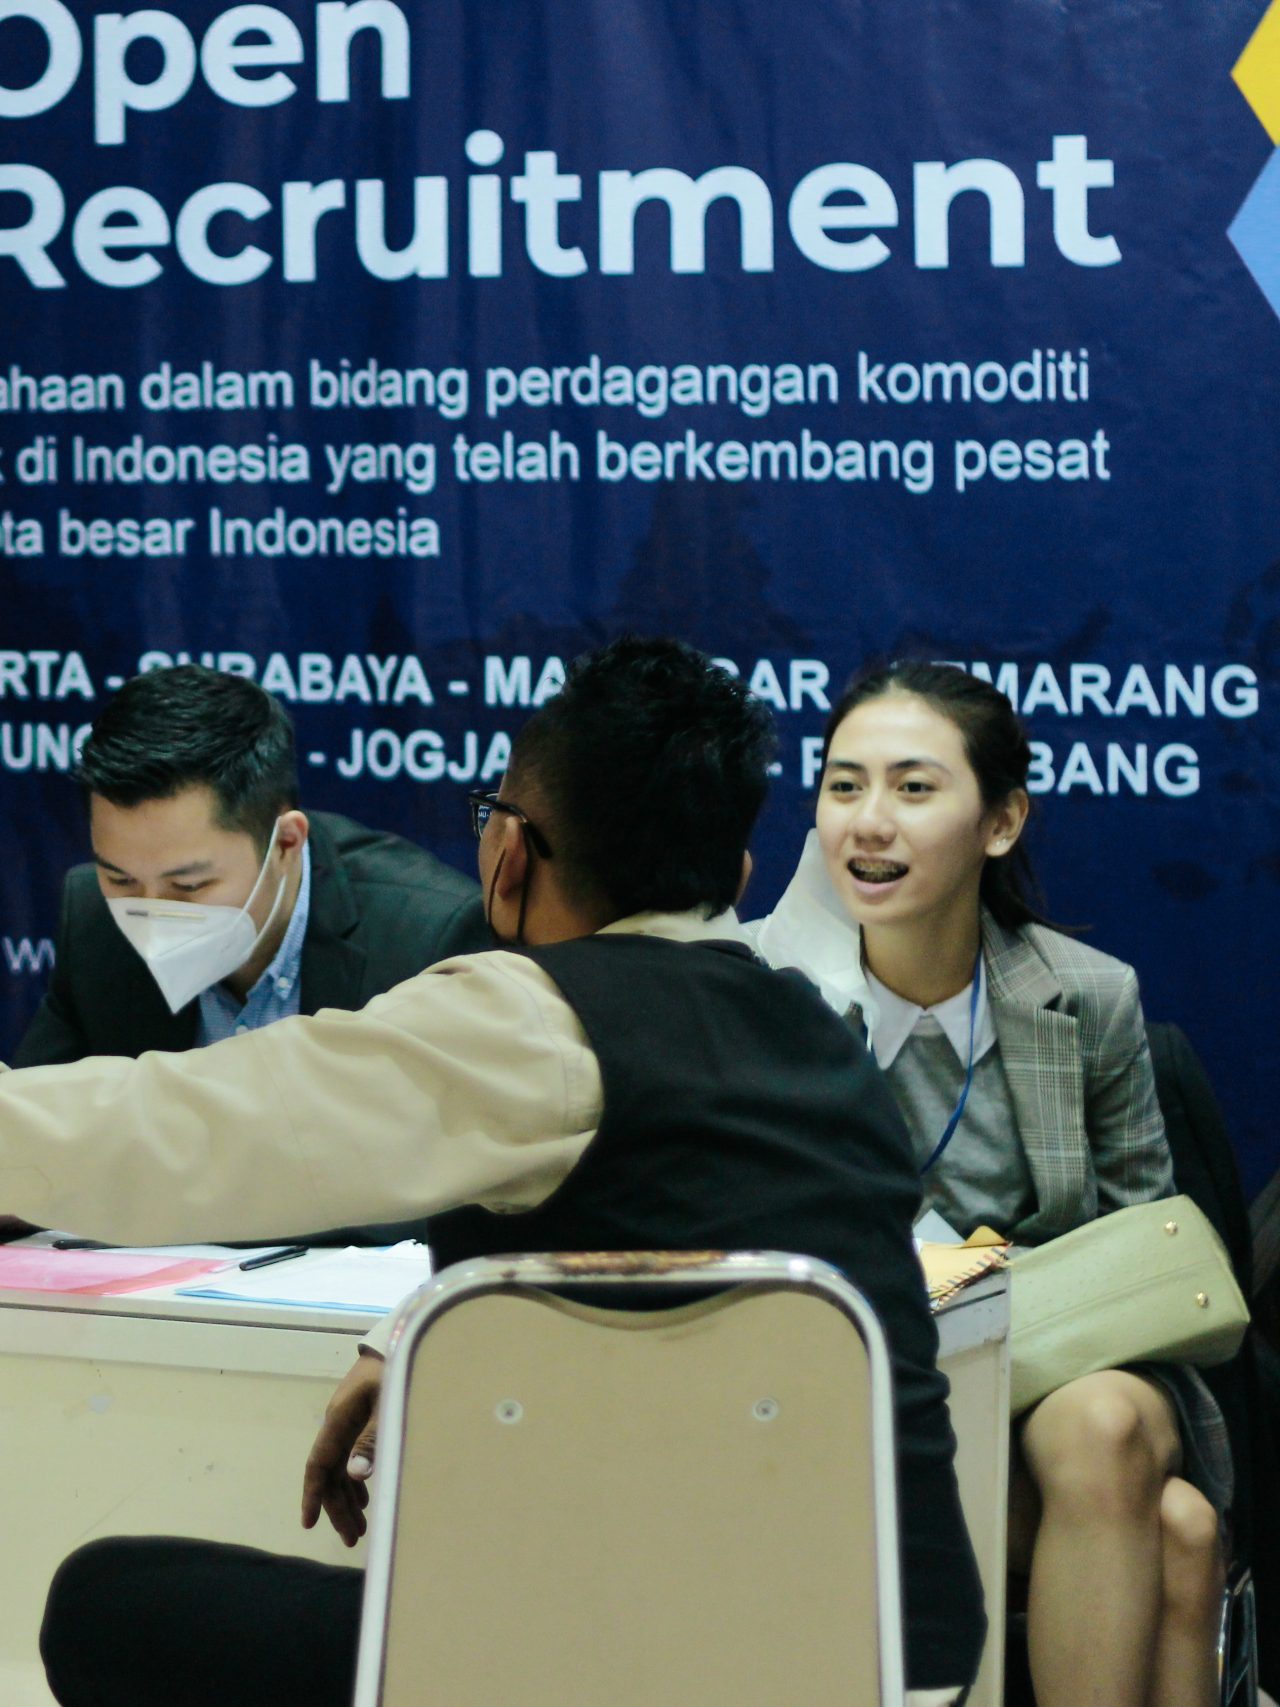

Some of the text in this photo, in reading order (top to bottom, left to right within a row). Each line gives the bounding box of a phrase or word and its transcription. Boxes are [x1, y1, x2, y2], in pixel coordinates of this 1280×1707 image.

[139, 361, 294, 411] dalam
[309, 358, 469, 419] bidang
[486, 354, 839, 418] perdagangan
[857, 348, 1090, 403] komoditi
[16, 435, 57, 484] di
[73, 433, 310, 483] Indonesia
[325, 442, 437, 494] yang
[452, 430, 580, 481] telah
[596, 428, 934, 493] berkembang
[954, 428, 1111, 492] pesat
[59, 508, 196, 557] besar
[209, 506, 441, 558] Indonesia
